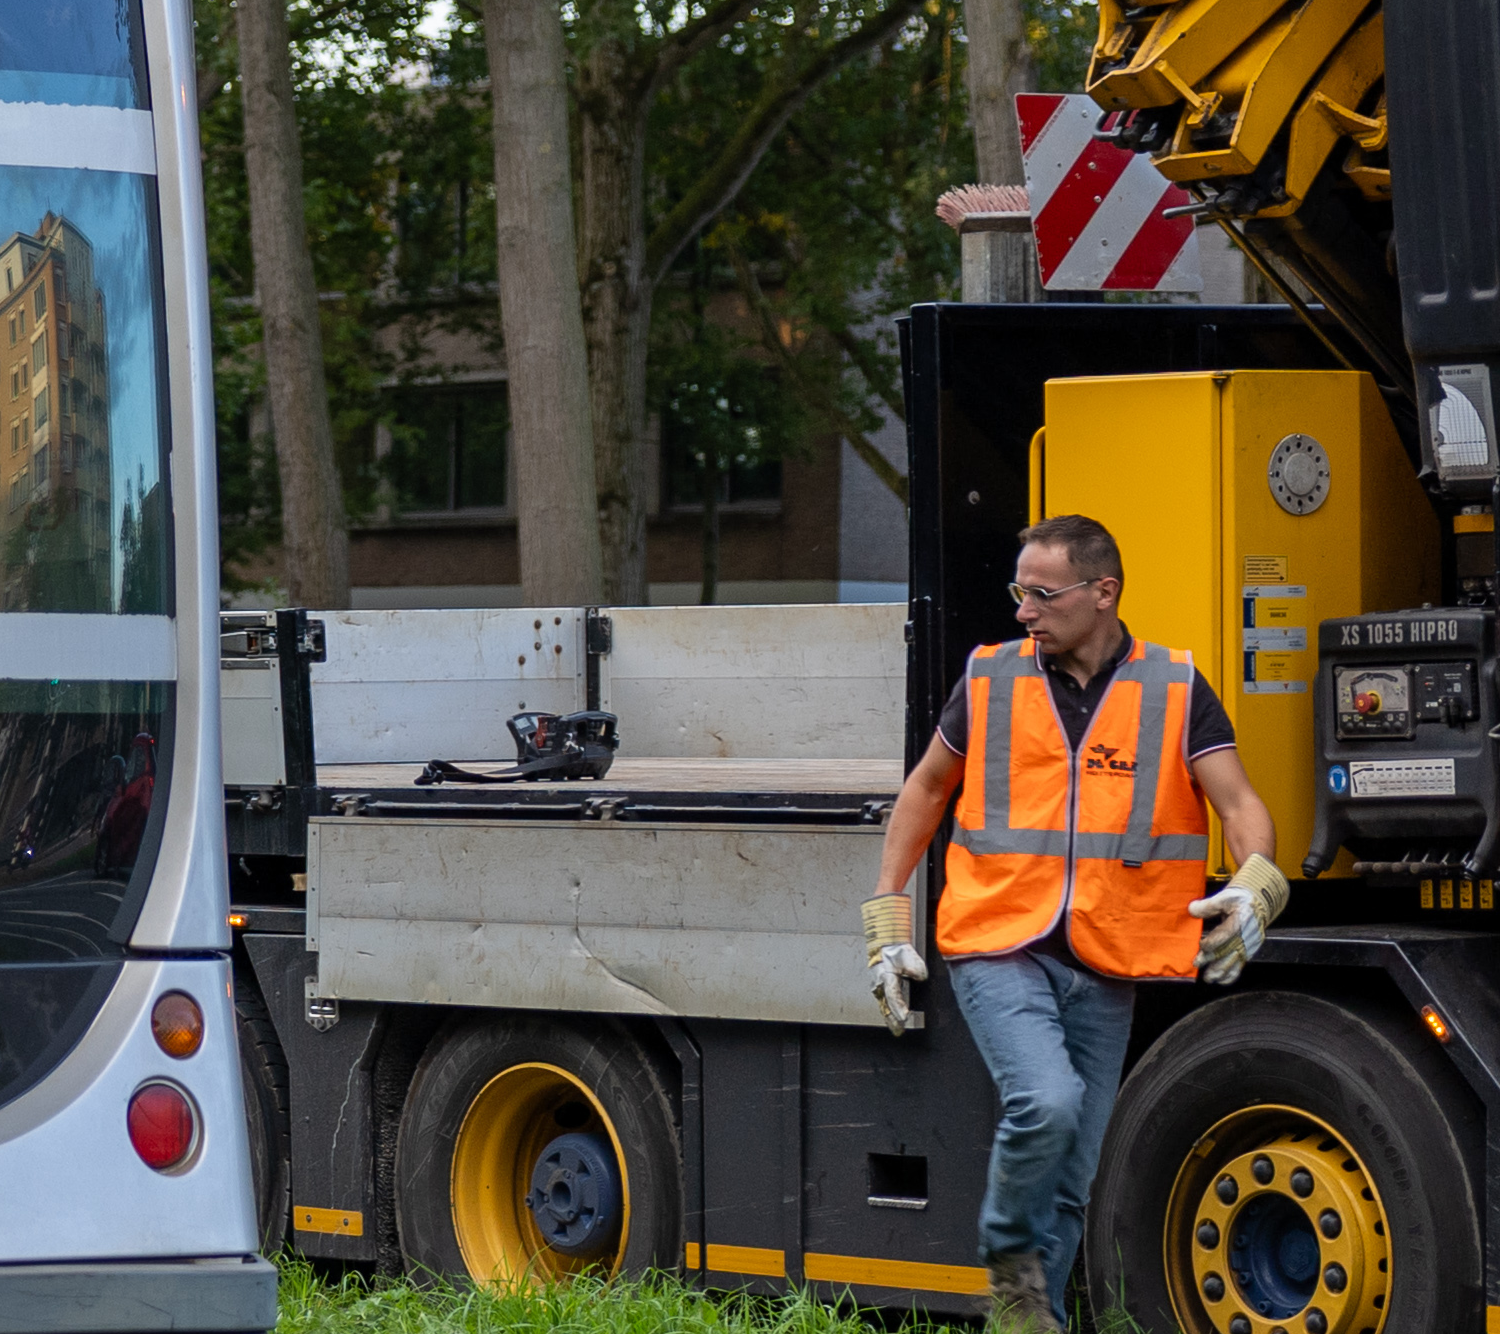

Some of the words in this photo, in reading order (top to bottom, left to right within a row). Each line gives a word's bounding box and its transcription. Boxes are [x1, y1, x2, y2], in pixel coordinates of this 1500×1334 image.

[1341, 624, 1360, 646] XS
[1366, 622, 1404, 645] 1055
[1410, 619, 1458, 643] HIPRO
